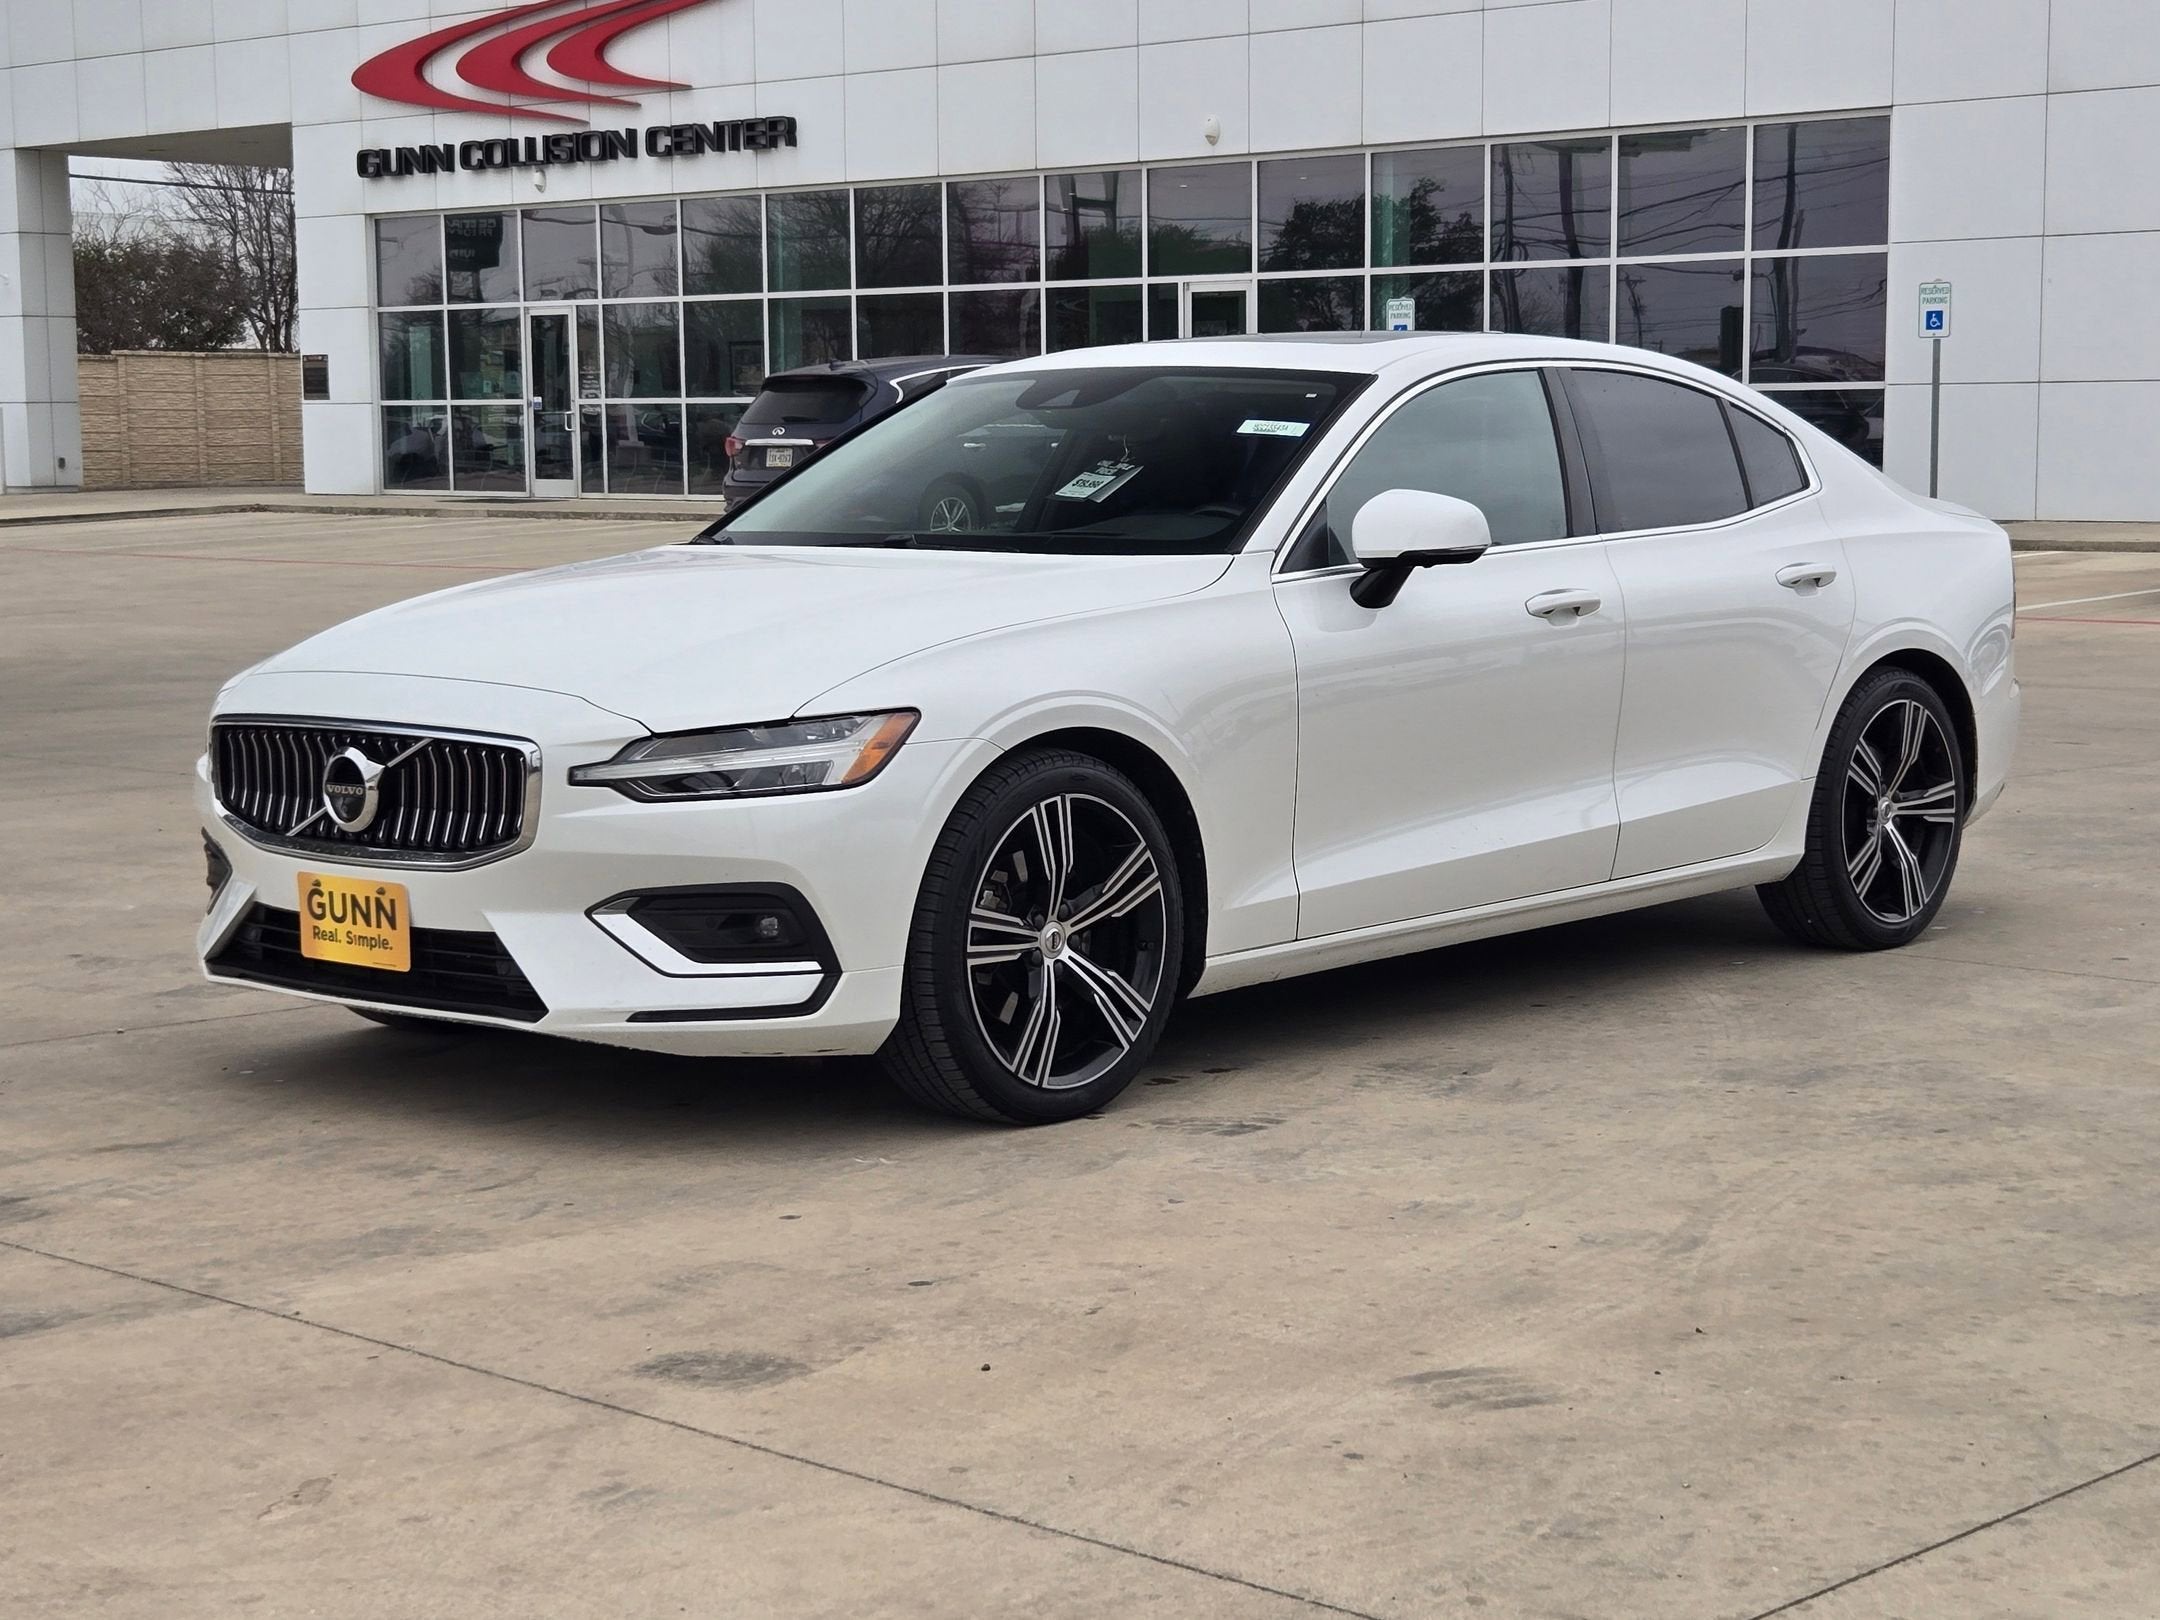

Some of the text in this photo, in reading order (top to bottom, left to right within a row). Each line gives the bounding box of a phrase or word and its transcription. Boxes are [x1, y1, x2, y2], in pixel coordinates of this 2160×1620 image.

[357, 116, 798, 178] GUNN COLLISION CENTER
[1921, 296, 1948, 305] PARKING
[326, 784, 364, 796] VOLVO
[307, 887, 397, 931] GUNN
[312, 925, 393, 951] Real. Simple.
